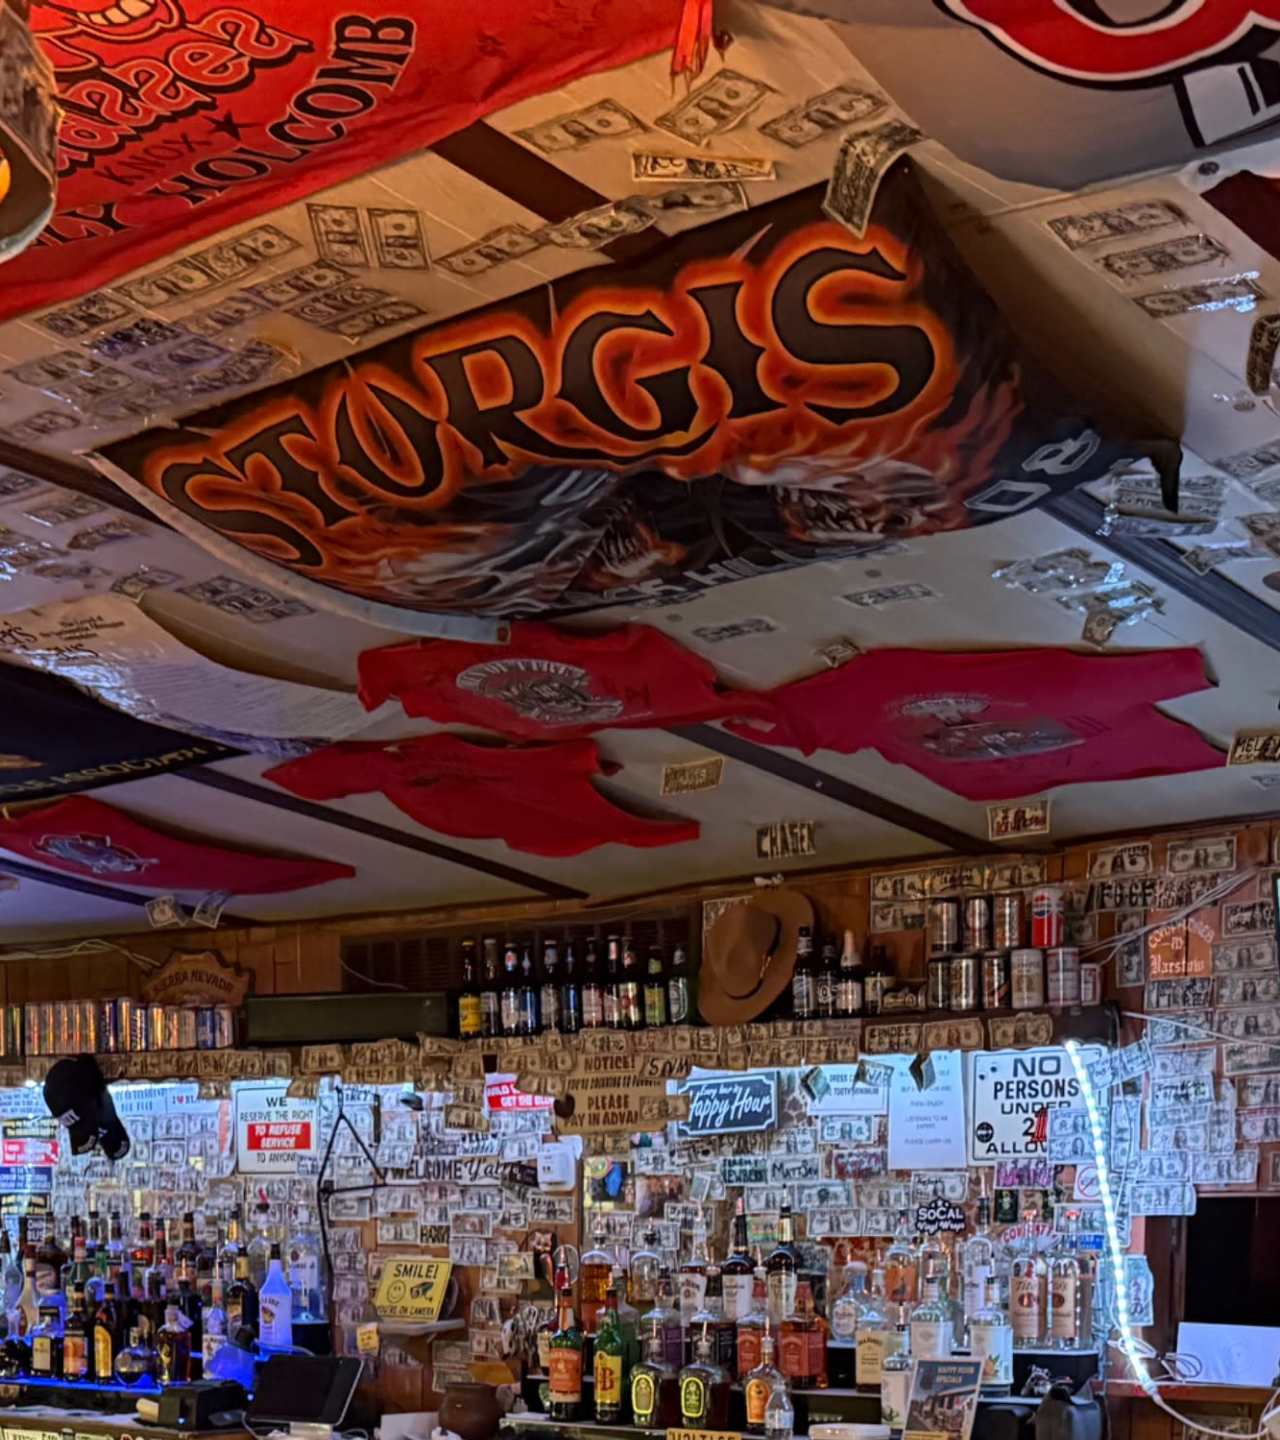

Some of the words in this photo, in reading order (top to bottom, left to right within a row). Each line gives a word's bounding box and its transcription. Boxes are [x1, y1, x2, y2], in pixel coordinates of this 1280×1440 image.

[145, 15, 417, 208] HOLCOMB
[95, 128, 215, 188] KNOX
[1012, 1055, 1062, 1078] NO
[992, 1078, 1080, 1101] PERSONS
[266, 1096, 289, 1108] WE
[730, 1087, 771, 1121] Hour
[240, 1111, 272, 1122] RESERVE
[274, 1110, 290, 1121] THE
[291, 1110, 314, 1121] RIGHT
[255, 1124, 267, 1136] TO
[269, 1123, 302, 1136] REFUSE
[260, 1136, 296, 1149] SERVICE
[256, 1152, 267, 1163] TO
[393, 1263, 439, 1279] SMILE!
